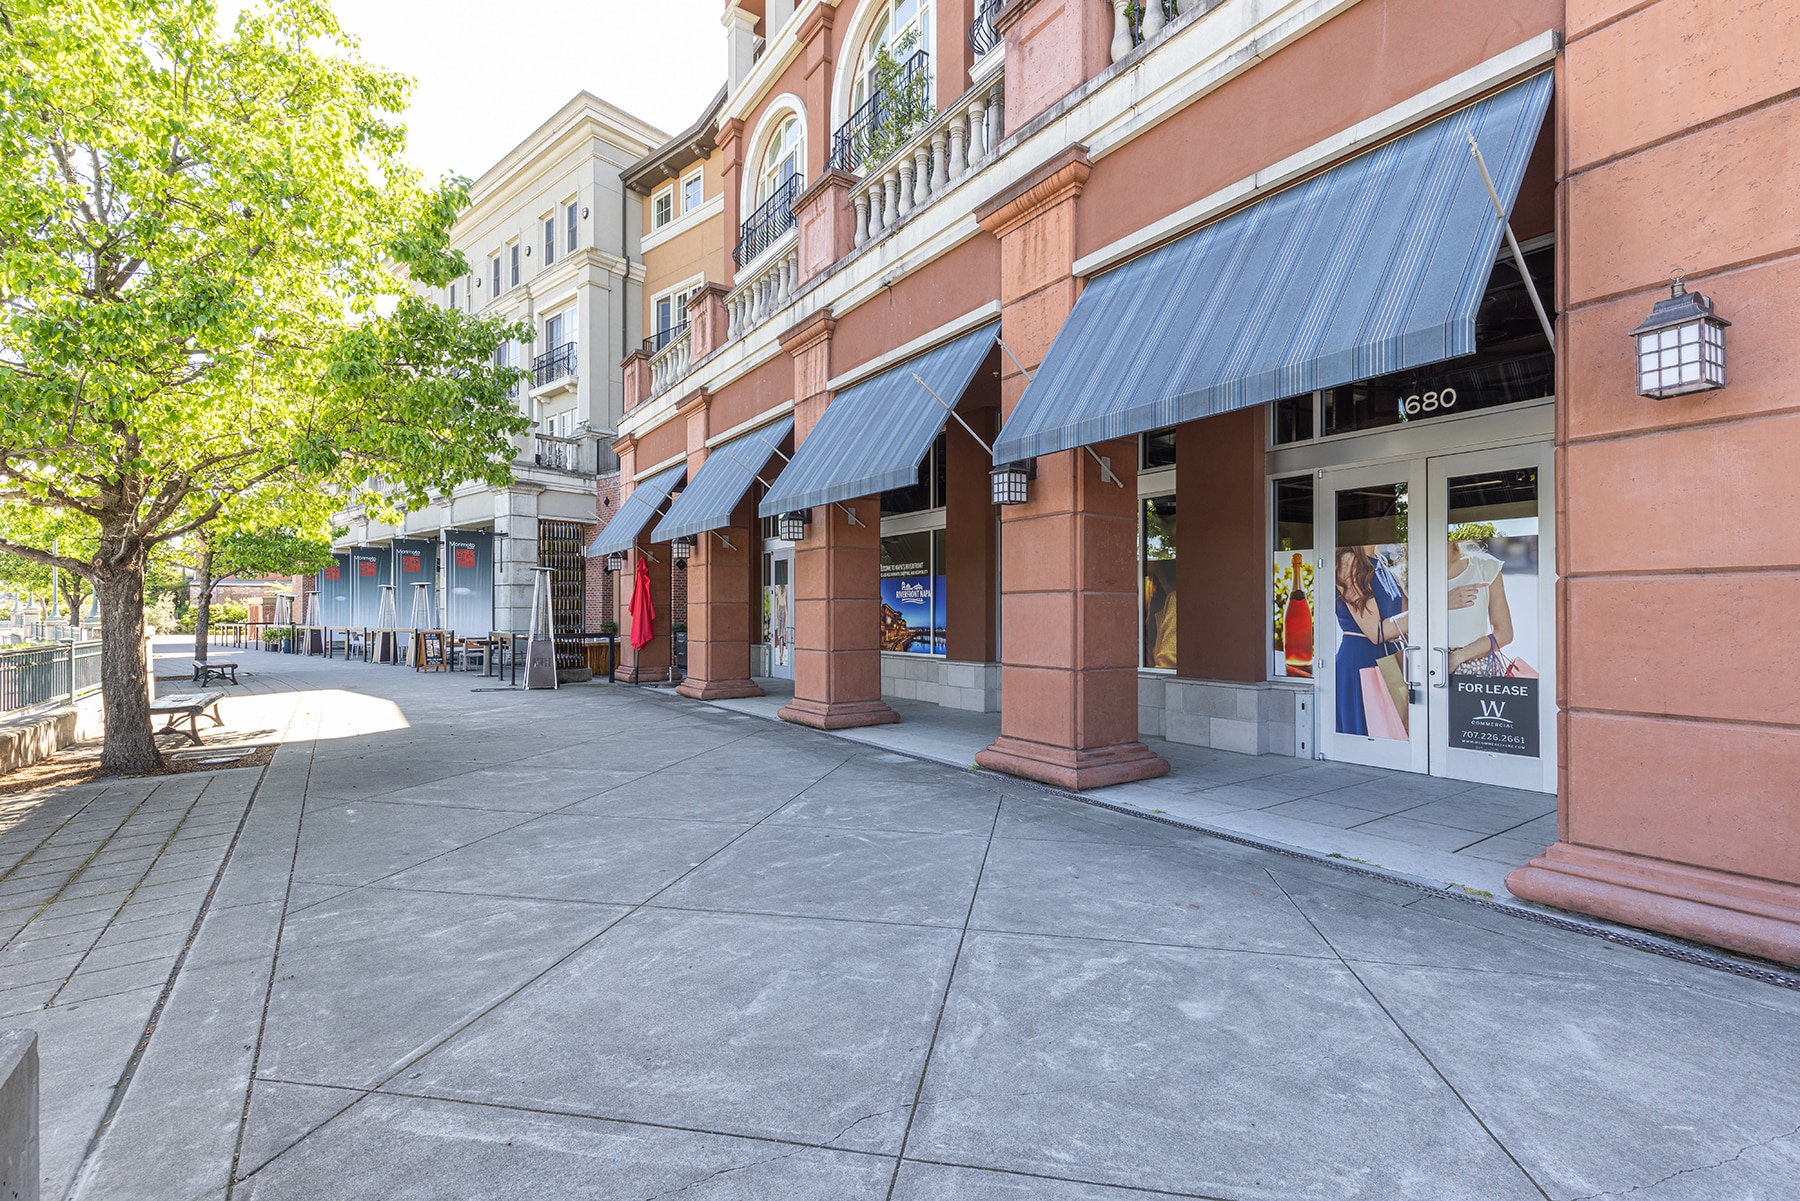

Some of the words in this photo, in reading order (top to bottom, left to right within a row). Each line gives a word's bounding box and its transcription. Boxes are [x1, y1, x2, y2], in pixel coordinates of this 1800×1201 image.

[1405, 388, 1457, 414] 680
[895, 590, 919, 599] RIVERFRONT
[1458, 682, 1483, 693] FOR
[1486, 684, 1528, 696] LEASE
[1480, 700, 1506, 717] W
[1471, 720, 1514, 729] COMMERCIAL
[1462, 731, 1525, 744] 707.226.2661
